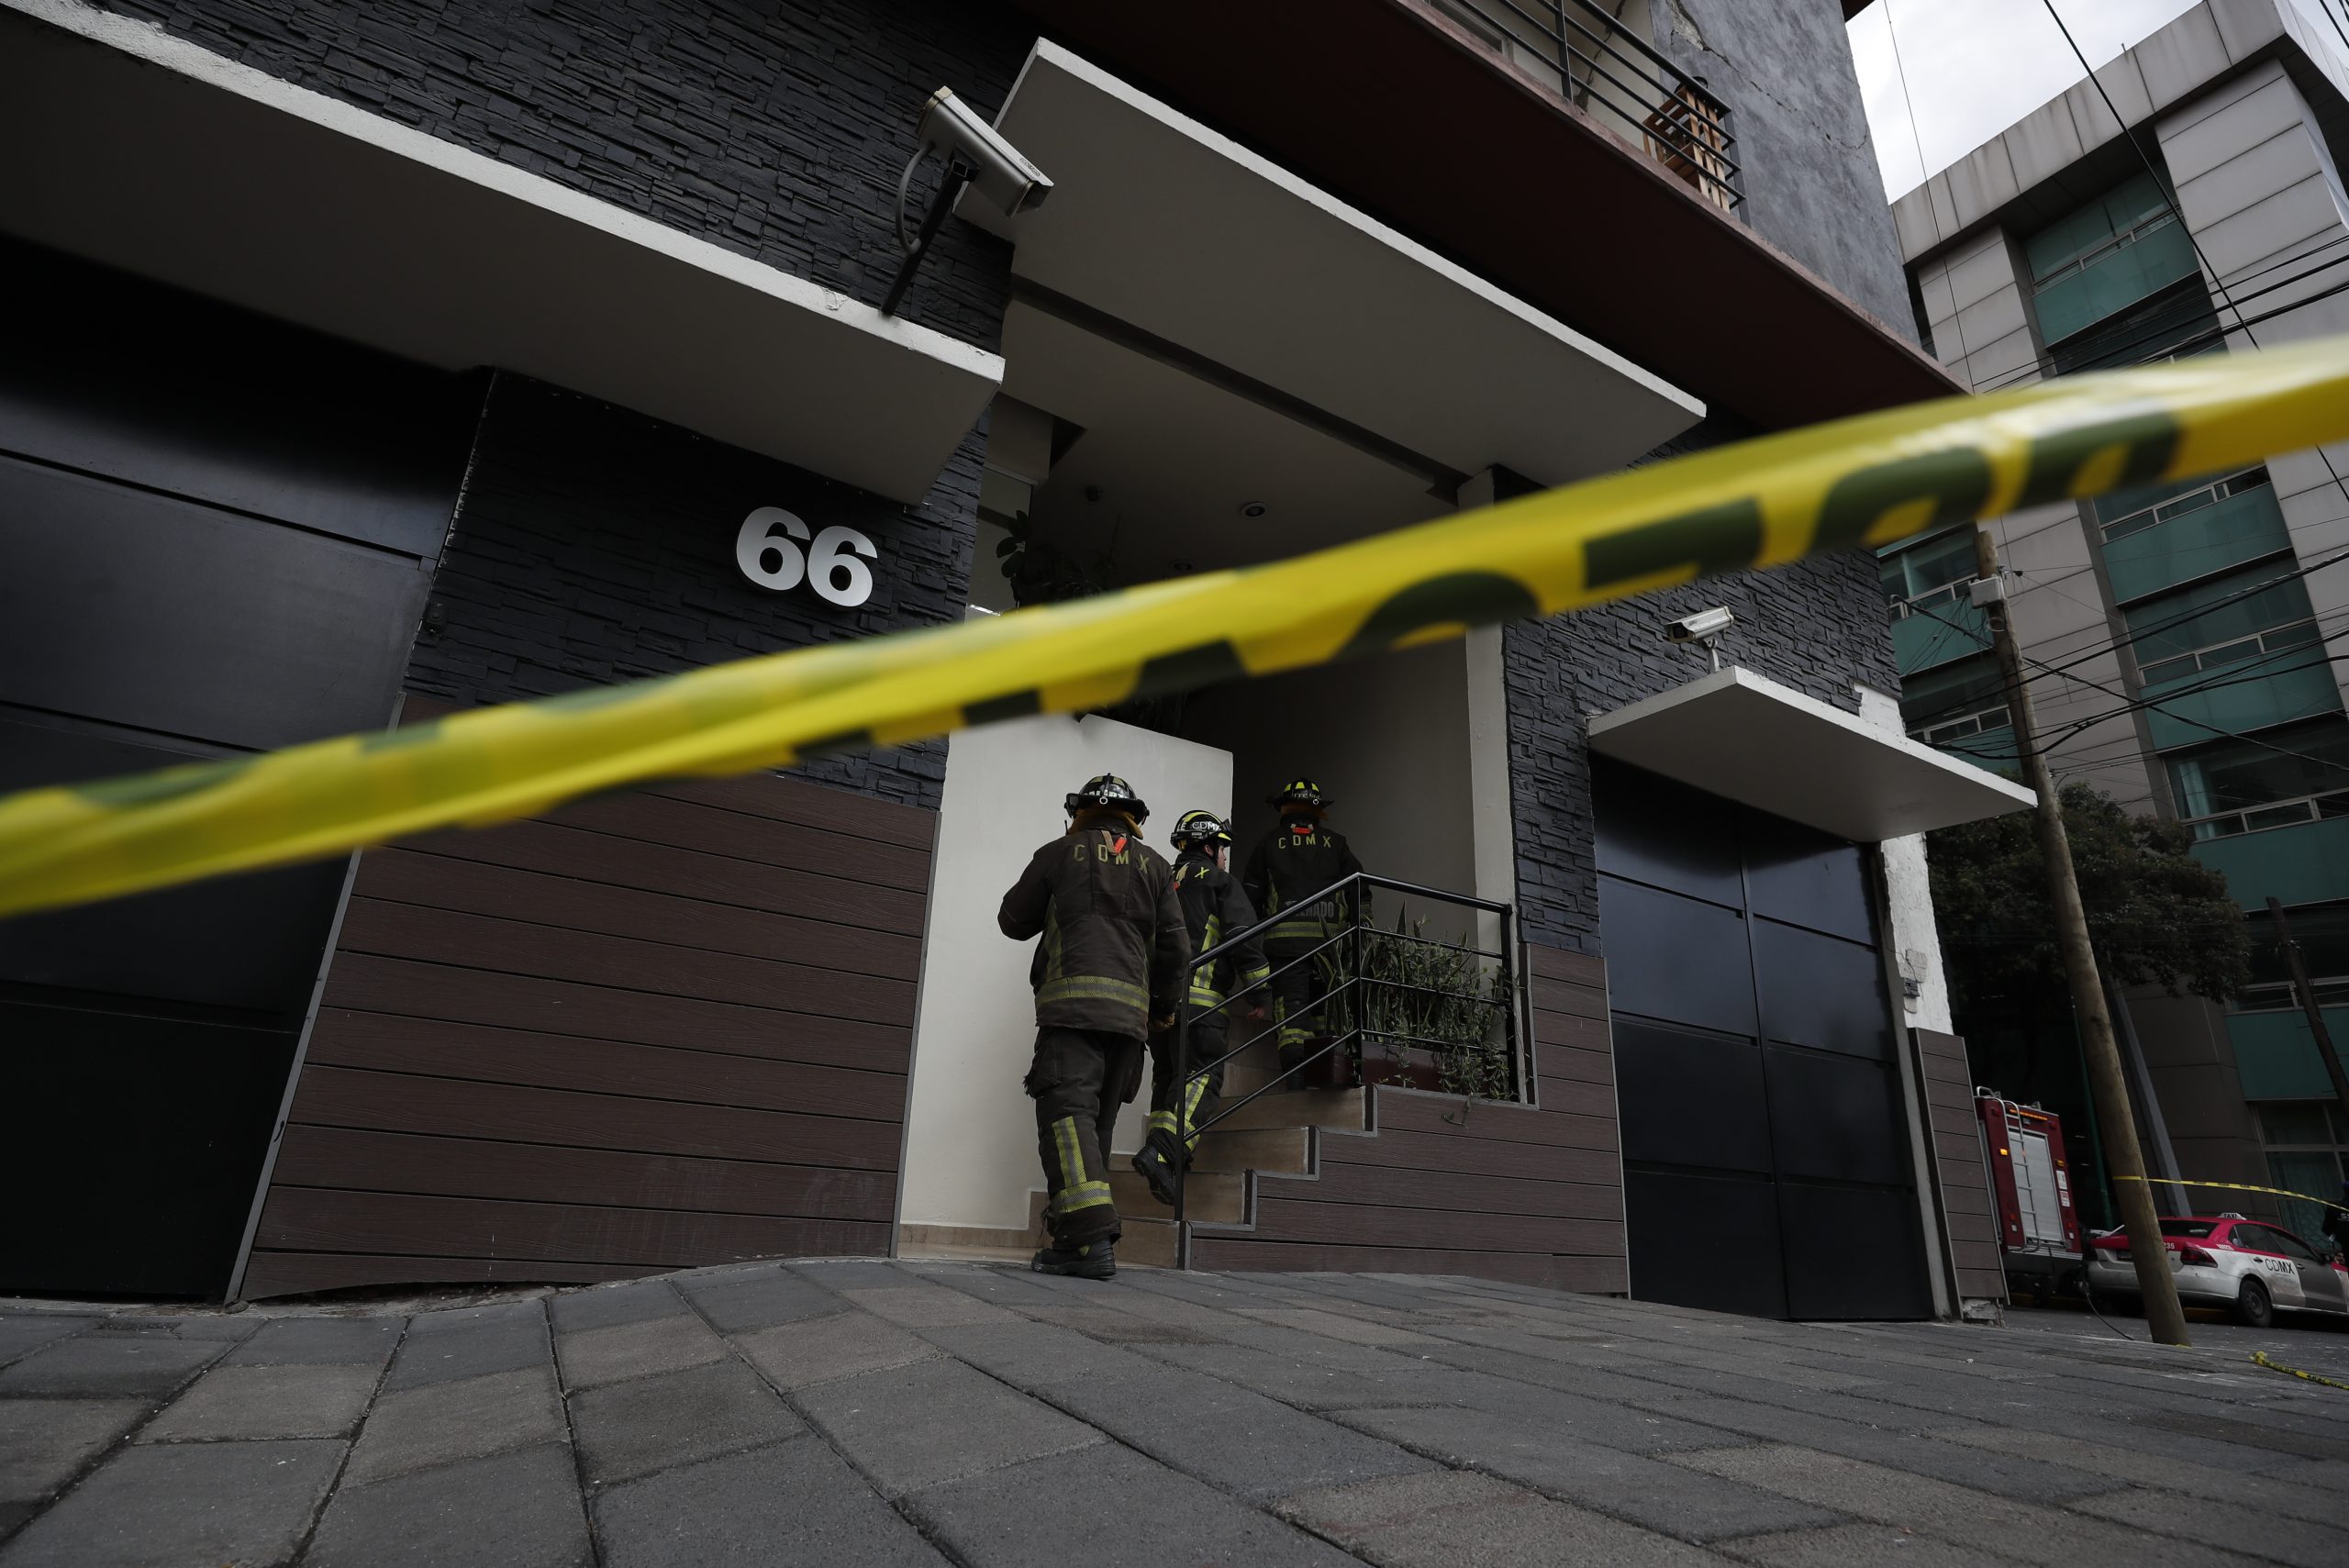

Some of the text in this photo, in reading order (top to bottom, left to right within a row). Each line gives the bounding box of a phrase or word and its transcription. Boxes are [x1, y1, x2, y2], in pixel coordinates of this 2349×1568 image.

[736, 506, 878, 607] 66
[1278, 833, 1331, 849] CDMX
[1074, 843, 1150, 874] CDMX
[2265, 1258, 2296, 1275] CDMX
